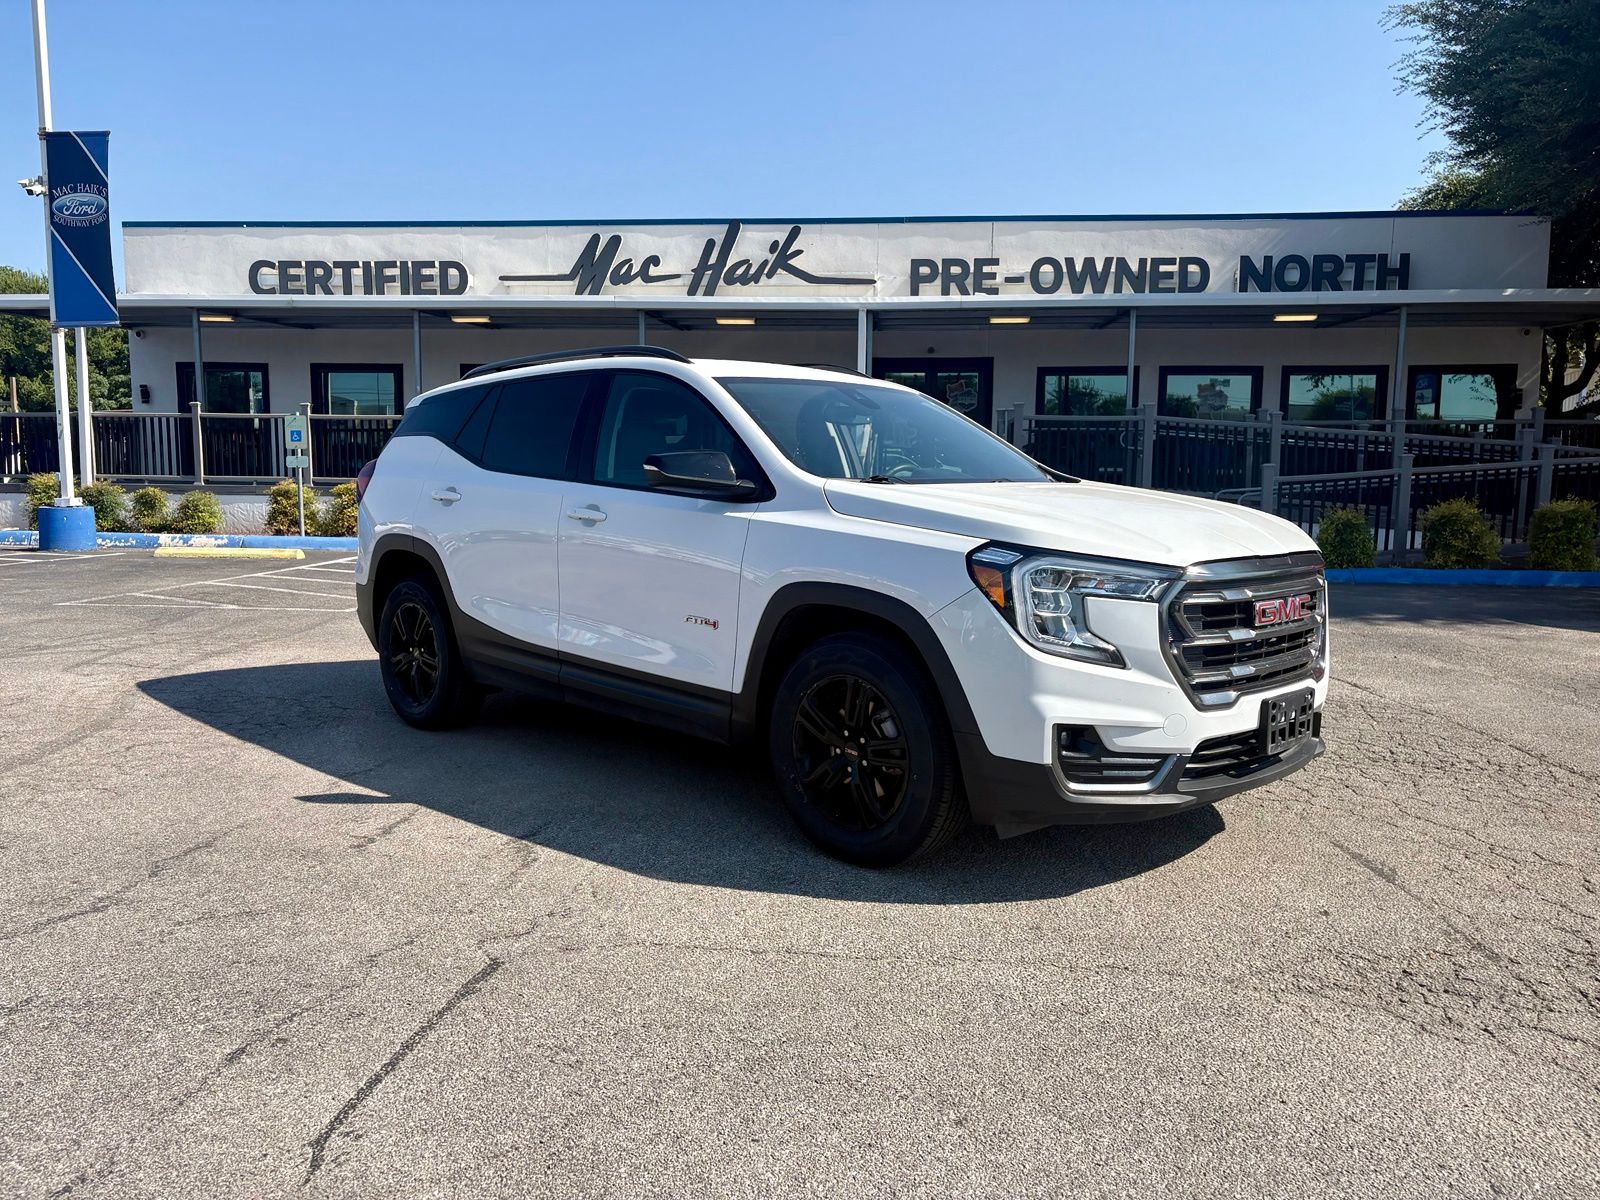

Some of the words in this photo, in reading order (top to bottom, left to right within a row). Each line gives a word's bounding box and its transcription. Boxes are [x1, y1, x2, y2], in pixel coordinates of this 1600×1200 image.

[52, 184, 74, 198] MAC
[77, 183, 107, 197] HAIK'S
[63, 197, 98, 215] Ford
[53, 214, 91, 227] SOUTHWAY
[91, 213, 107, 226] FORD
[248, 260, 469, 295] CERTIFIED
[565, 233, 681, 296] Mac
[687, 220, 822, 296] Haik
[909, 257, 1211, 296] PRE-OWNED
[1238, 253, 1411, 293] NORTH
[1254, 595, 1312, 626] GMC
